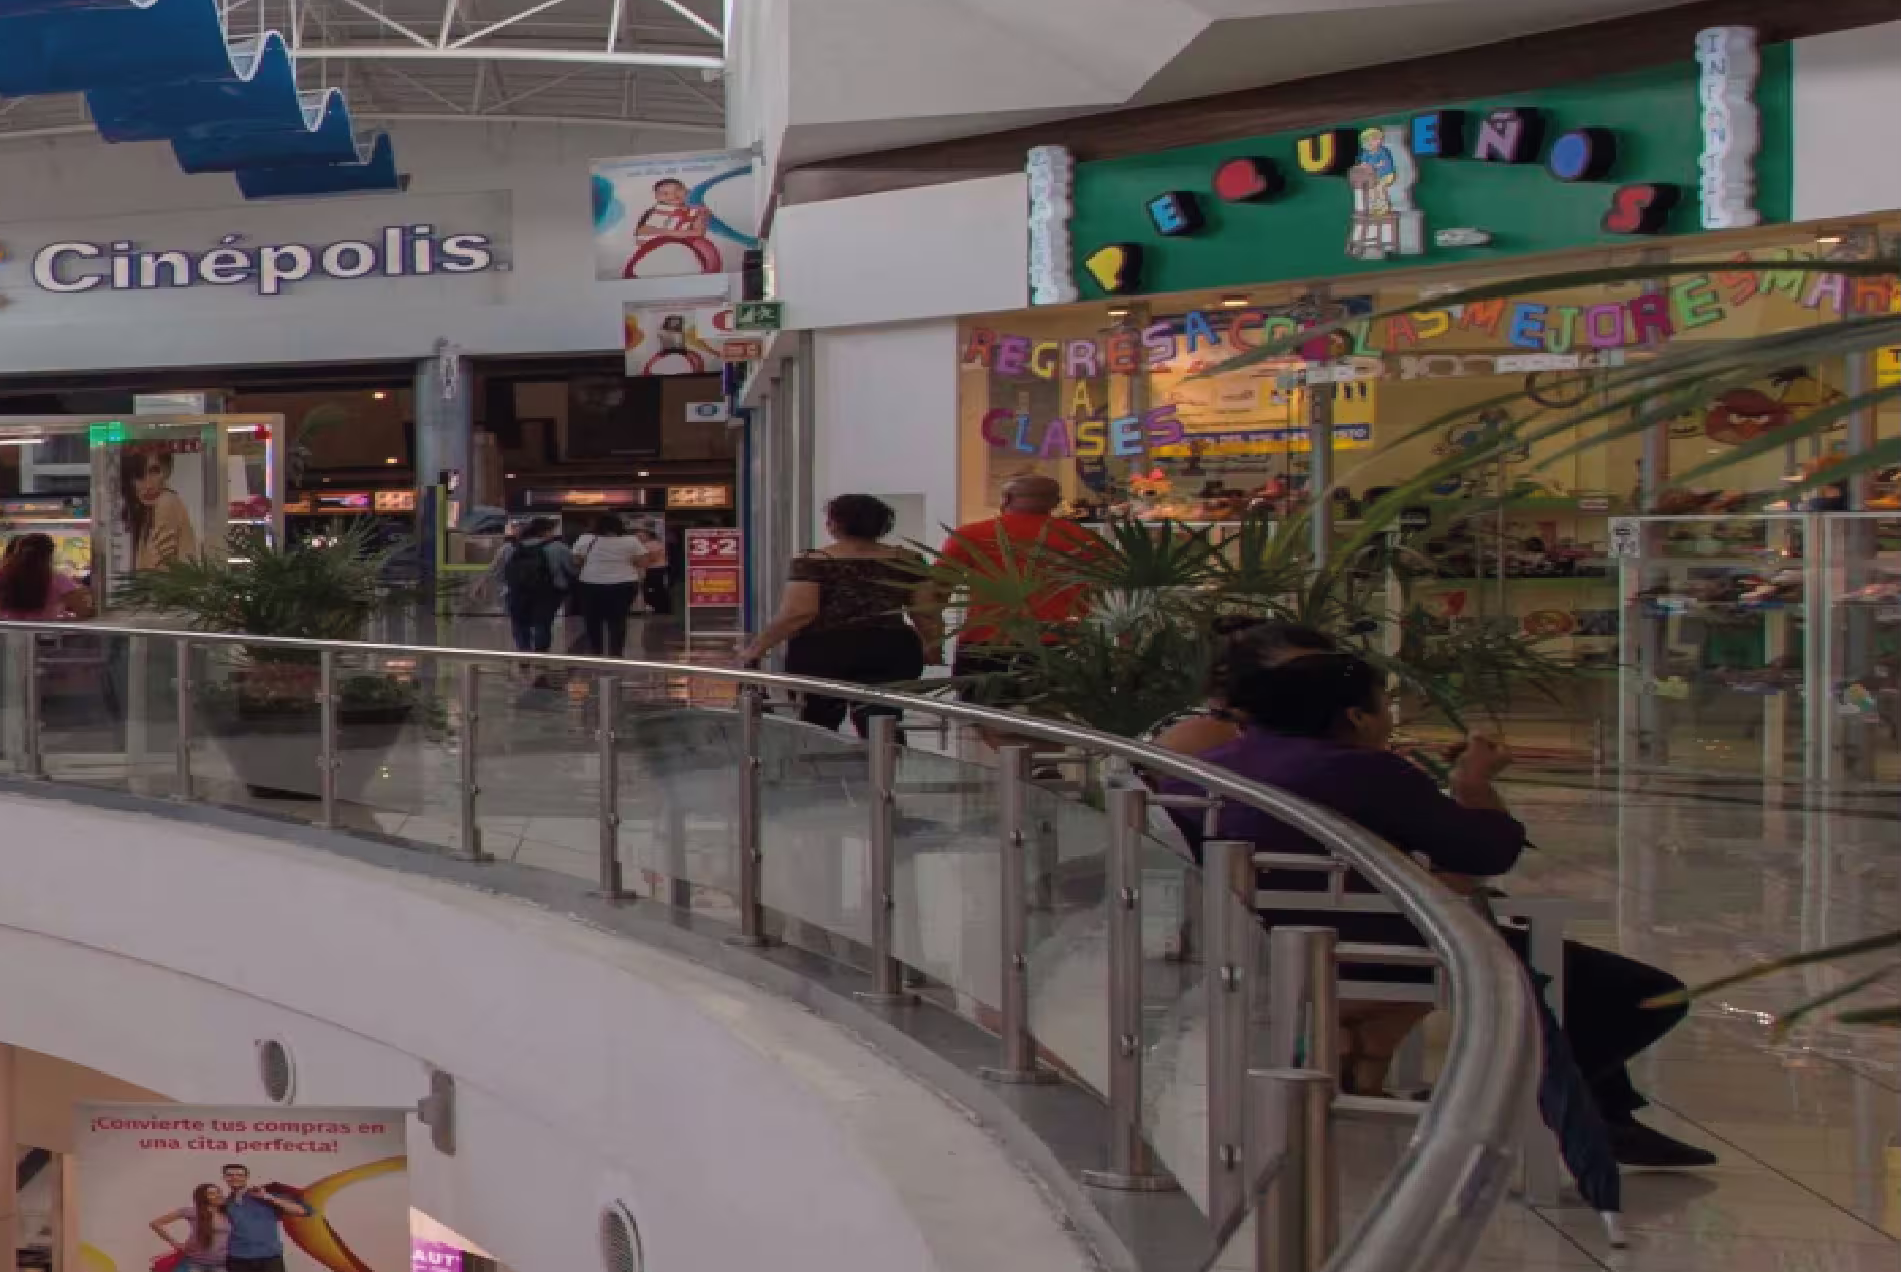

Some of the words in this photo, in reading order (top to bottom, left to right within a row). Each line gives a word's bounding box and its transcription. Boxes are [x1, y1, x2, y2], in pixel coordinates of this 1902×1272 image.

[1705, 32, 1727, 224] INFANTIL
[31, 223, 494, 296] Cinépolis
[963, 309, 1222, 379] REGRESA
[1460, 250, 1759, 354] MEJORES
[981, 403, 1184, 459] CLASES
[90, 1114, 205, 1132] ¡Convierte
[211, 1118, 247, 1133] tus
[252, 1119, 351, 1136] compras
[358, 1121, 386, 1134] en
[138, 1138, 181, 1150] una
[188, 1136, 229, 1151] cita
[235, 1138, 339, 1154] perfecta!
